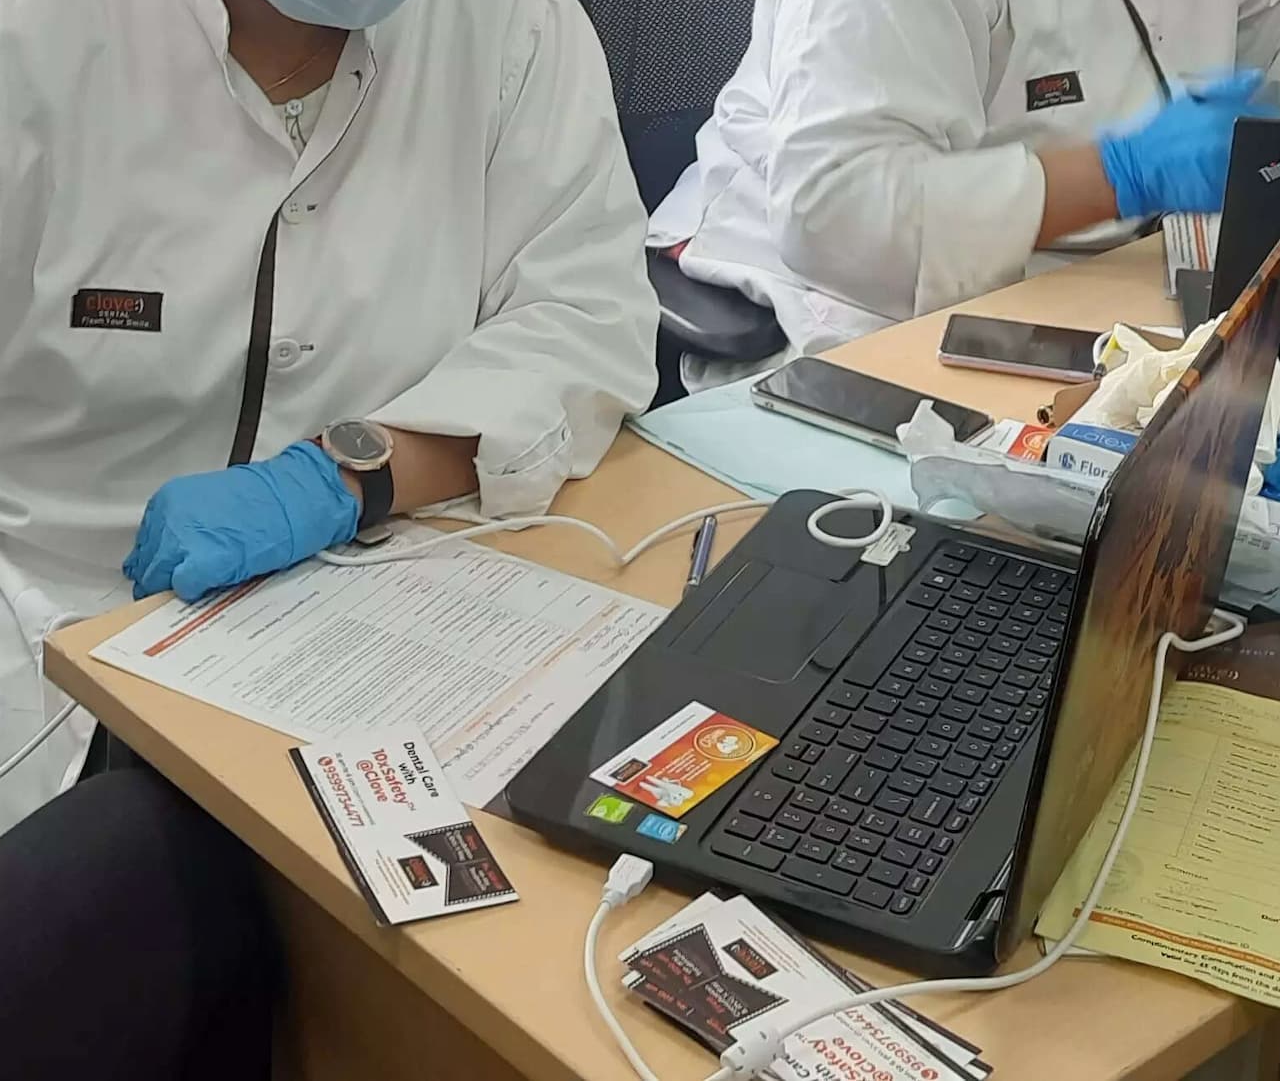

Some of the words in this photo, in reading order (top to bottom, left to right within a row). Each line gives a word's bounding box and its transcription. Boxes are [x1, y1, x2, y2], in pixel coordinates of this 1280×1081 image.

[1072, 427, 1131, 450] Latex
[356, 759, 389, 803] @Clove
[398, 762, 415, 785] with
[403, 741, 428, 775] Dental
[421, 774, 440, 798] Care
[322, 764, 365, 828] 9599734477
[1130, 934, 1199, 959] Complimentary
[1200, 953, 1257, 976] Consultation
[1258, 970, 1275, 981] and
[1211, 965, 1231, 978] days
[1231, 969, 1254, 985] from
[1255, 978, 1270, 990] the
[833, 1037, 893, 1081] @Clove
